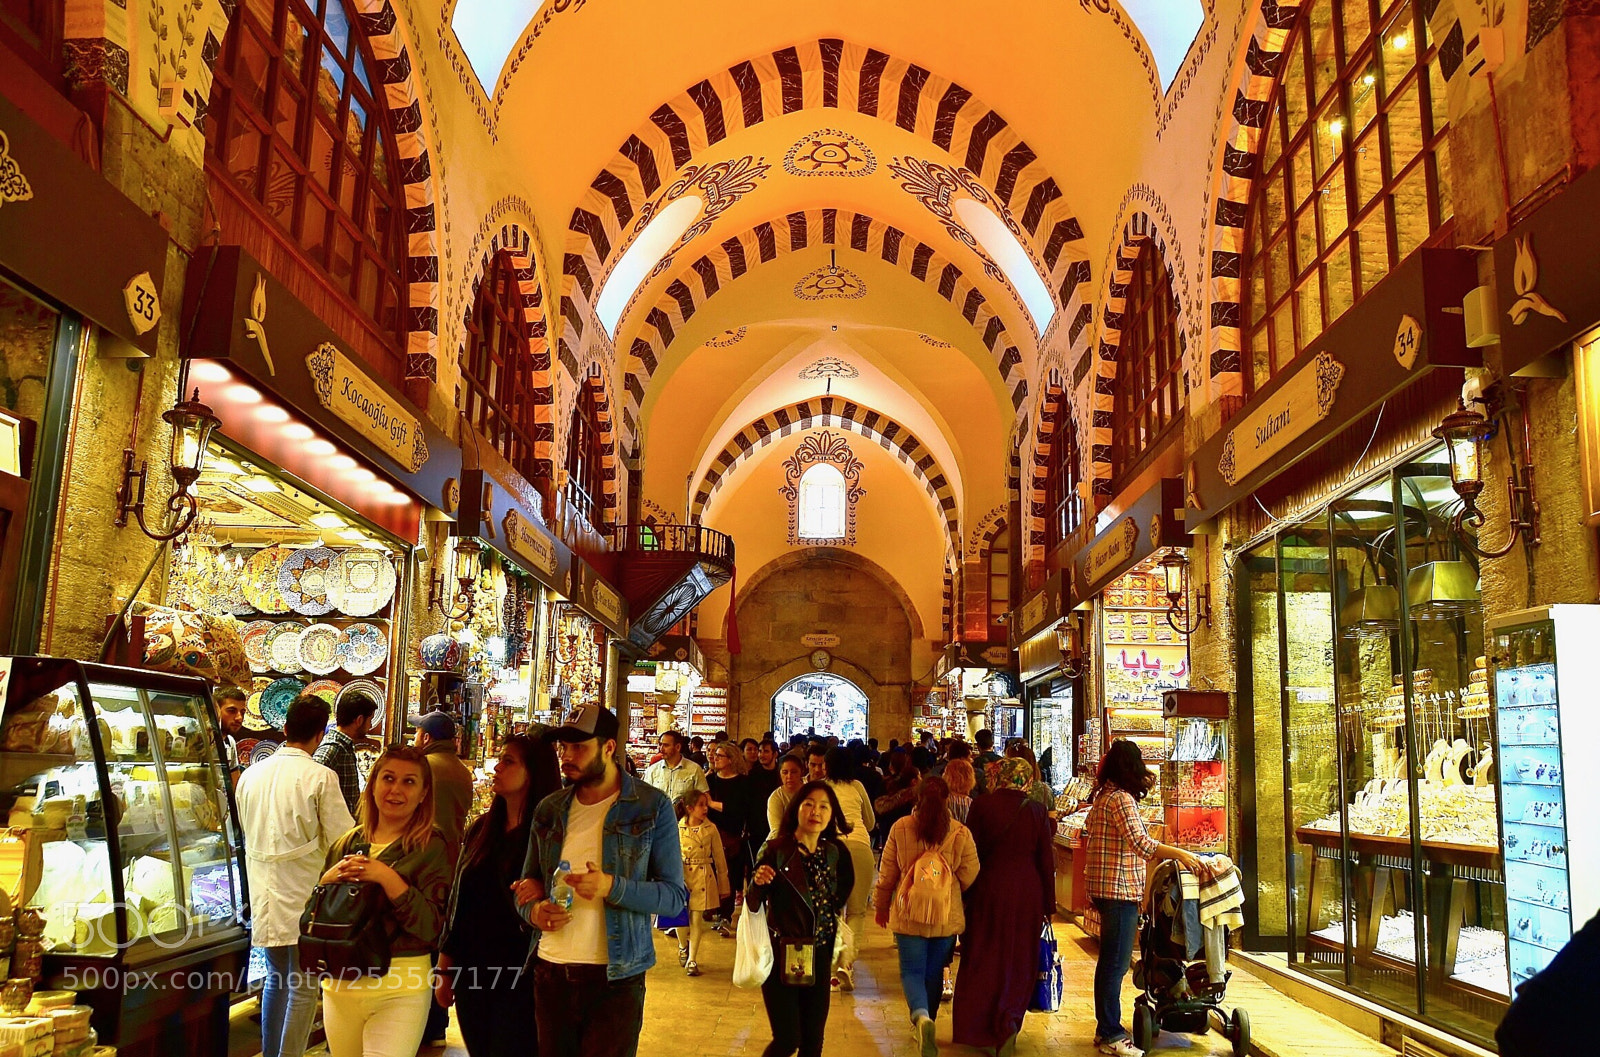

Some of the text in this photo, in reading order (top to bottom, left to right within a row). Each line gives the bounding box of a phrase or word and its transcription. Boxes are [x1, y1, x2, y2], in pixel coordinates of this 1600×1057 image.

[133, 284, 155, 322] 33
[1398, 326, 1415, 357] 34
[340, 376, 408, 448] Kocaoğlu Gift
[1255, 401, 1292, 450] Sultani
[1121, 649, 1161, 678] بابا
